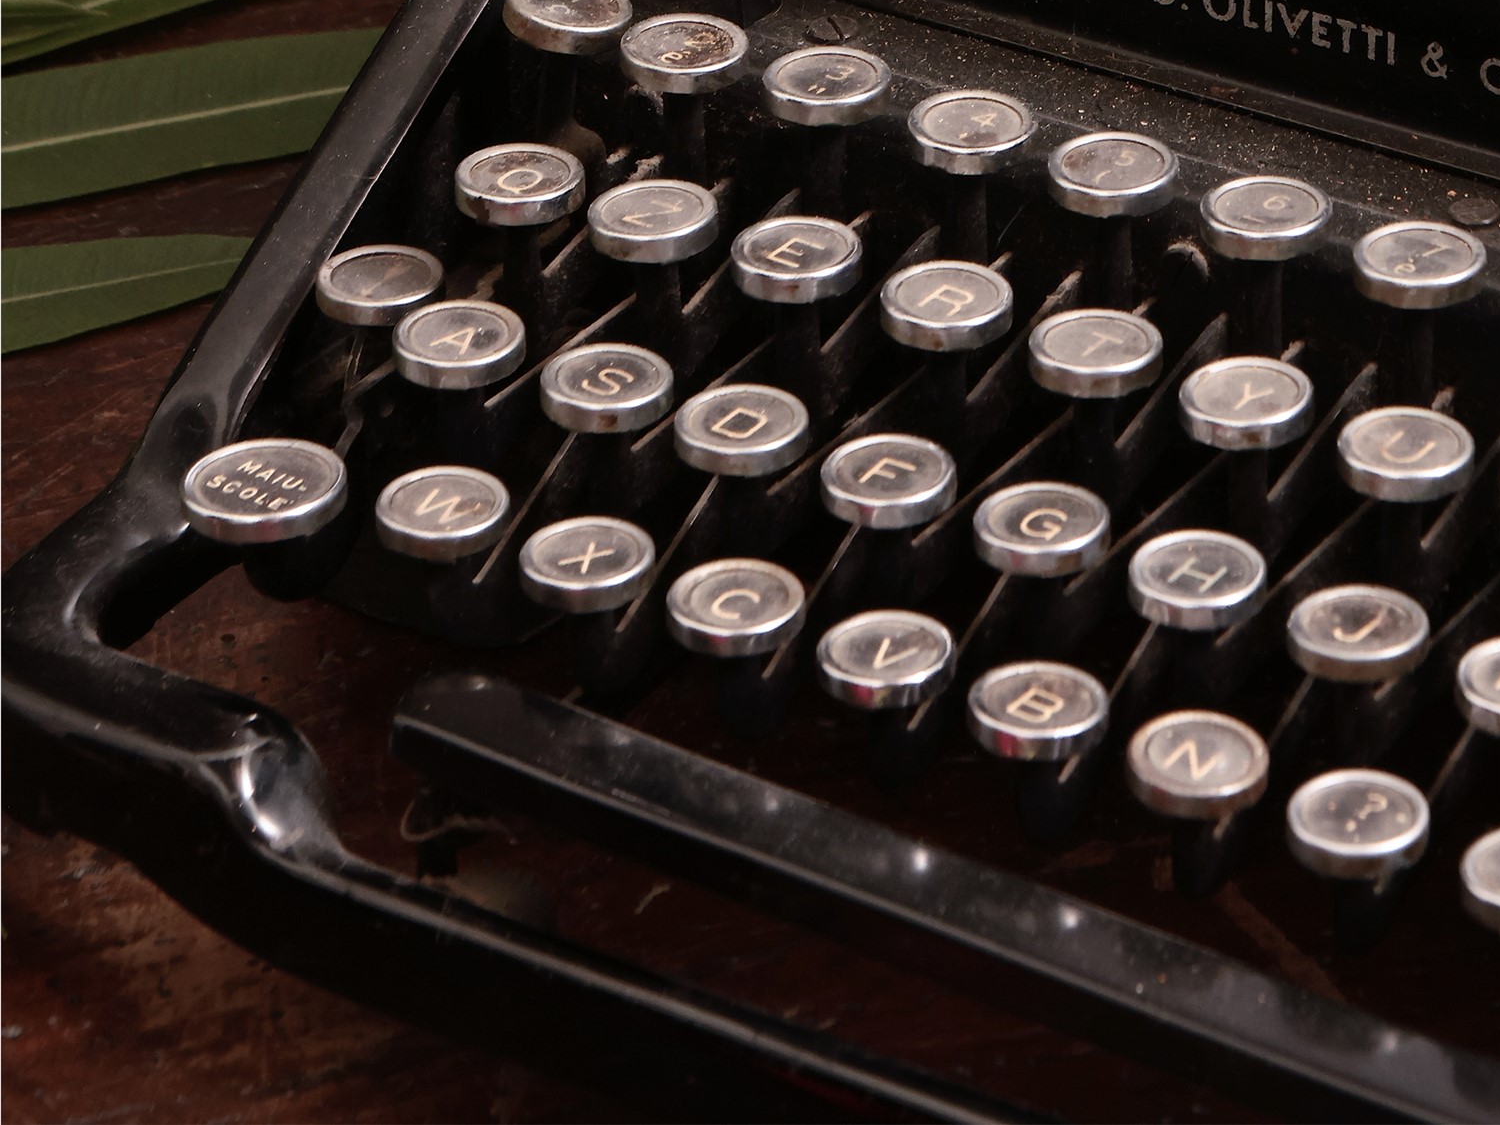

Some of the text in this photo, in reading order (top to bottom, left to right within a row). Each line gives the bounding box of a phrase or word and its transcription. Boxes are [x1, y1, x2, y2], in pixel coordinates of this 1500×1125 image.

[825, 65, 857, 81] 3
[1420, 41, 1447, 79] &
[970, 111, 999, 129] 4
[1116, 149, 1140, 168] 5
[497, 168, 544, 195] Q
[622, 198, 686, 228] Z
[1263, 193, 1293, 212] 6
[767, 236, 827, 268] E
[917, 282, 976, 318] R
[428, 325, 476, 356] A
[1081, 329, 1124, 358] T
[580, 366, 635, 397] S
[1233, 381, 1275, 412] Y
[710, 406, 769, 440] D
[1380, 430, 1437, 464] U
[236, 459, 308, 493] MAIU-
[858, 456, 917, 485] F
[413, 487, 478, 525] W
[1019, 506, 1070, 541] G
[557, 540, 616, 575] X
[1167, 556, 1228, 594] H
[710, 587, 761, 621] C
[1332, 607, 1390, 644] J
[872, 637, 920, 671] V
[1005, 686, 1066, 724] B
[1163, 738, 1220, 781] N
